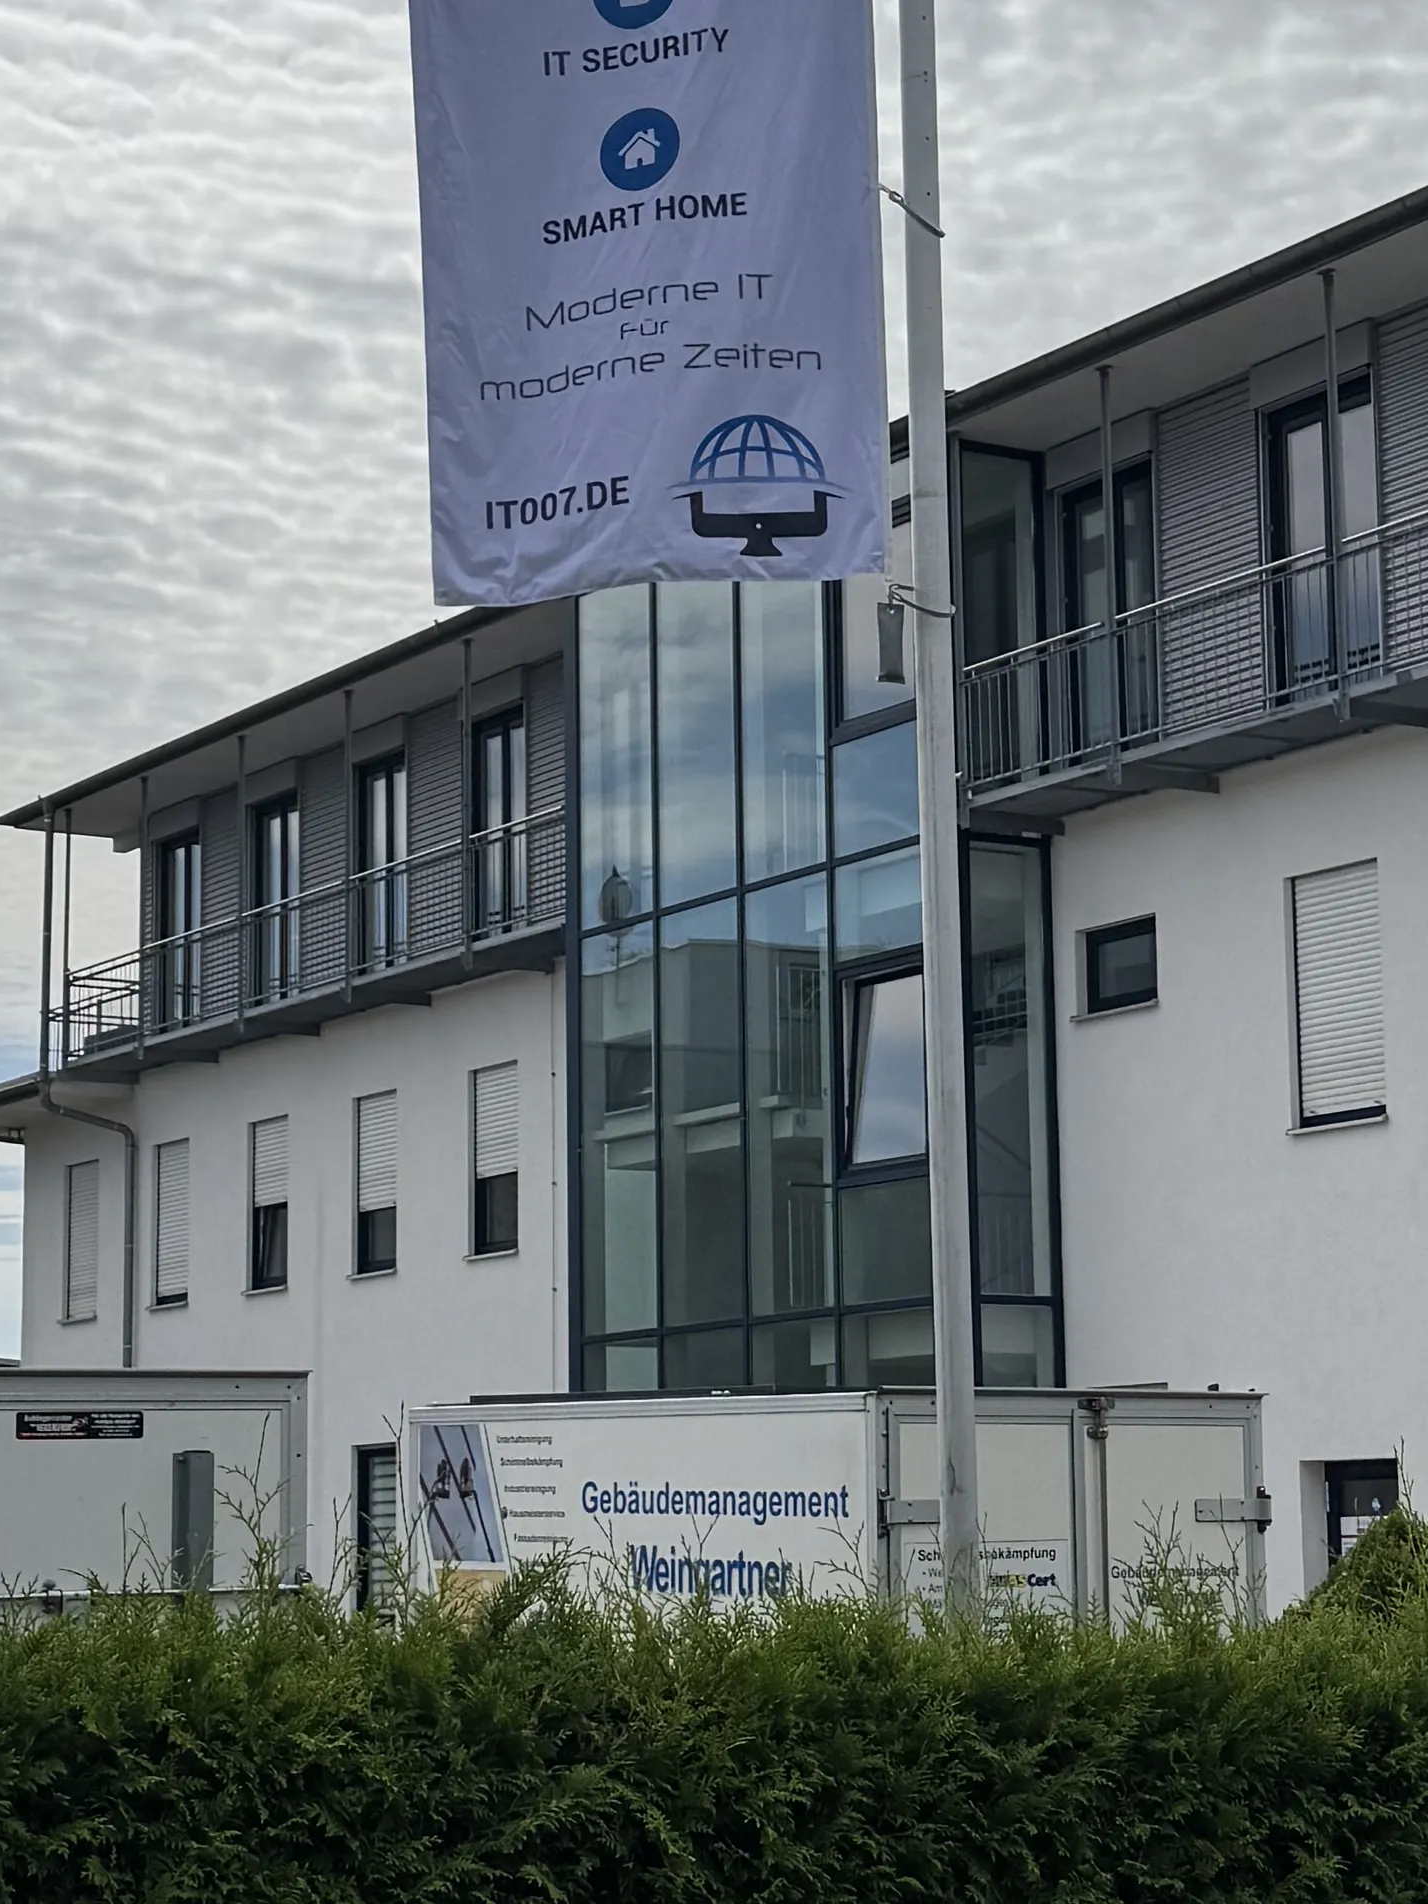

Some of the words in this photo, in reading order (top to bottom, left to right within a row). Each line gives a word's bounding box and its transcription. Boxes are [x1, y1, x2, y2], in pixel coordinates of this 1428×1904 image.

[544, 51, 570, 76] IT
[583, 28, 729, 72] SECURITY
[543, 202, 644, 244] SMART
[656, 193, 747, 220] HOME
[526, 282, 718, 331] Moderne
[739, 274, 772, 299] IT
[480, 353, 665, 400] moderne
[683, 343, 821, 370] Zeiten
[486, 476, 629, 529] IT007.DE
[582, 1481, 849, 1526] Gebäudemanagement
